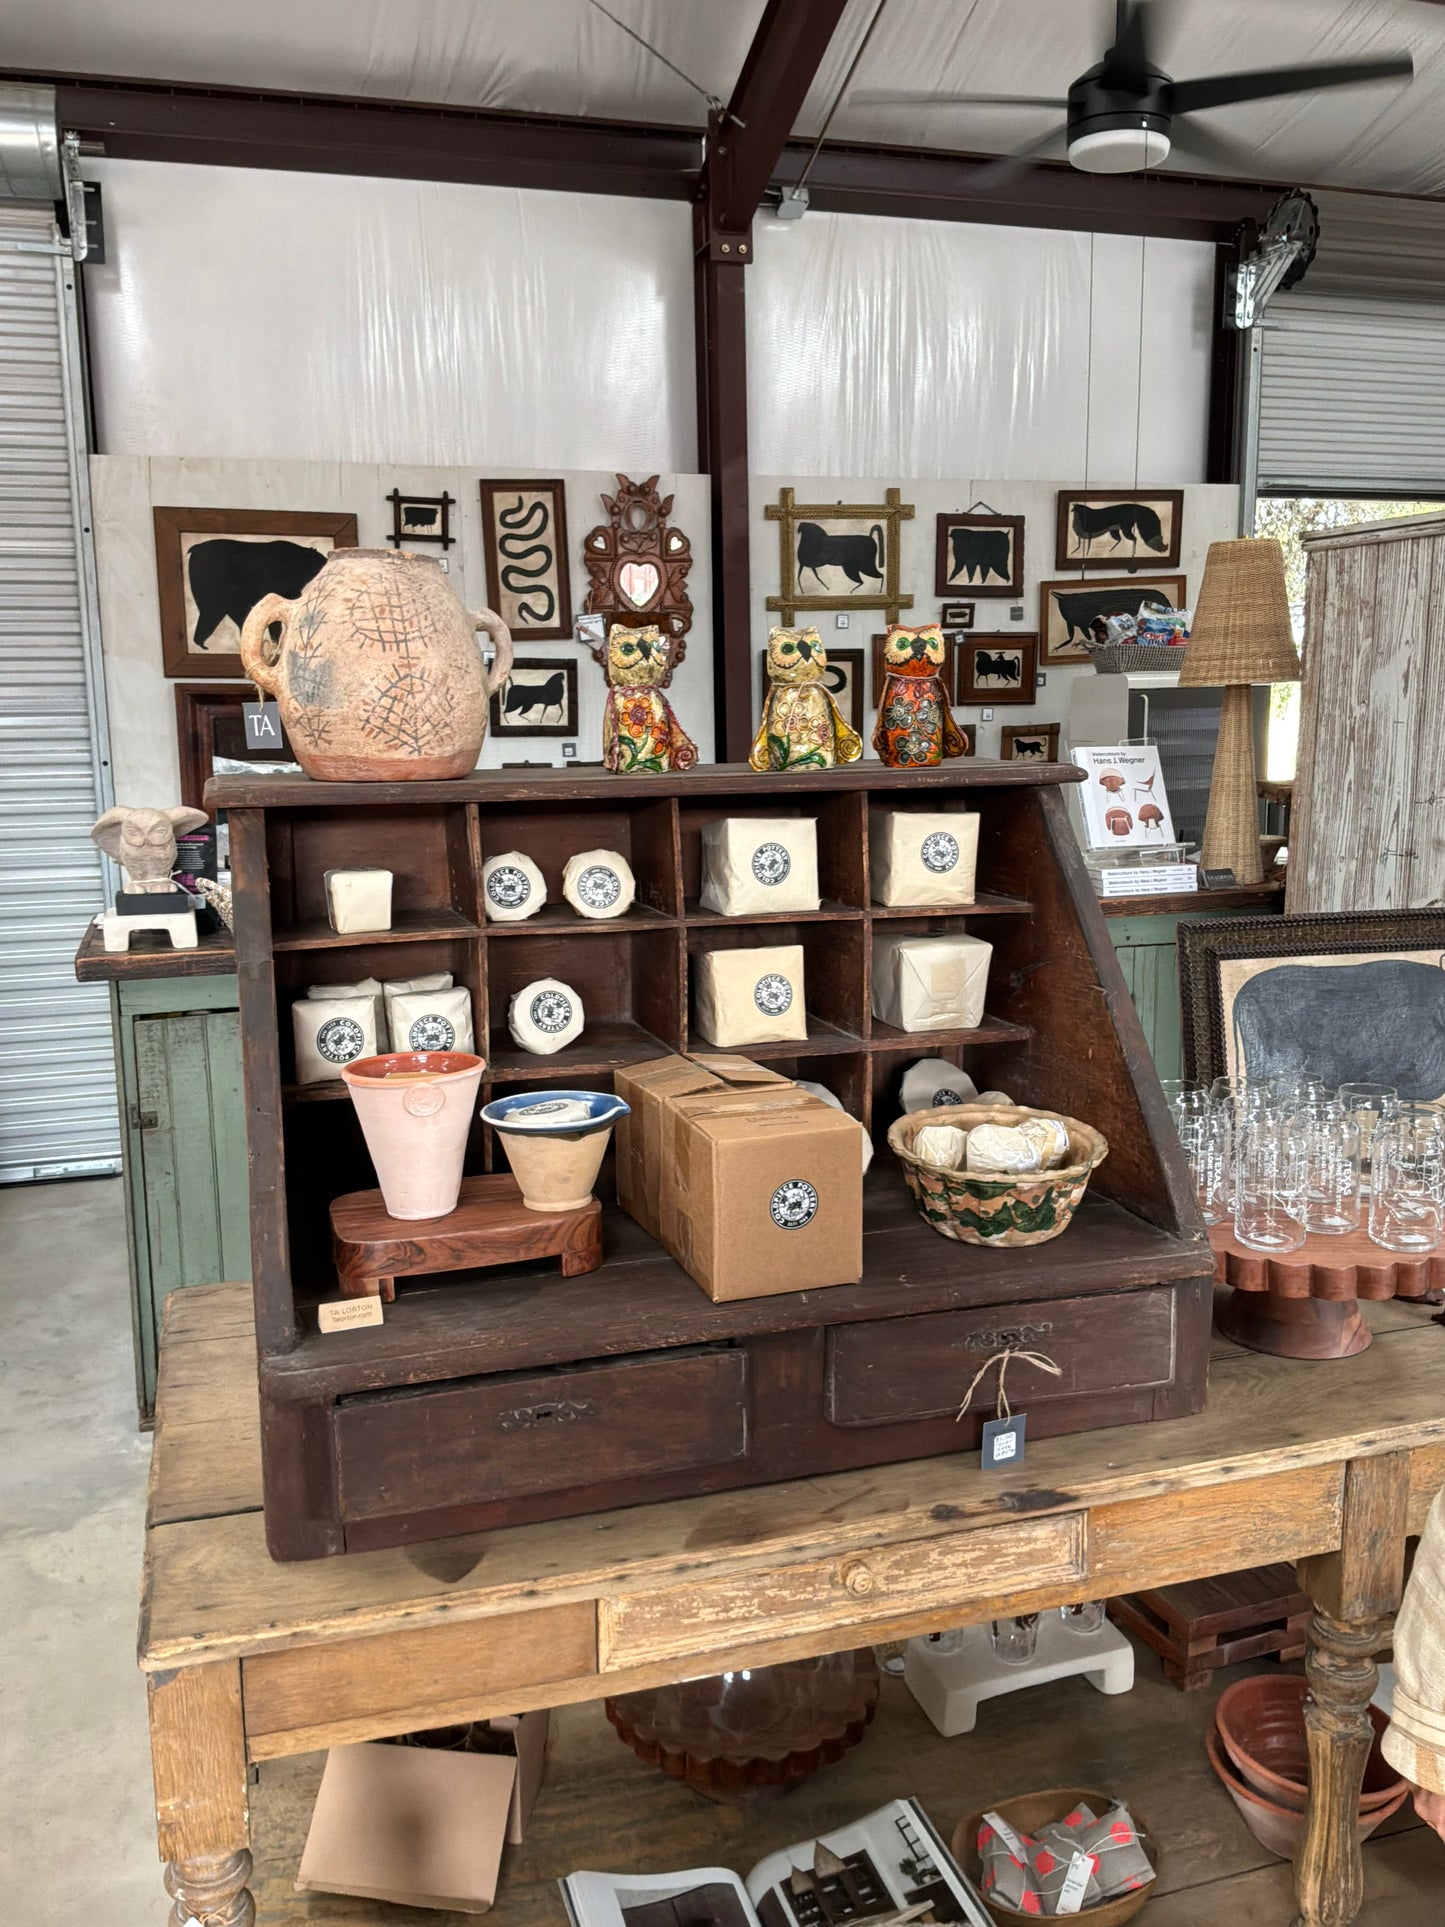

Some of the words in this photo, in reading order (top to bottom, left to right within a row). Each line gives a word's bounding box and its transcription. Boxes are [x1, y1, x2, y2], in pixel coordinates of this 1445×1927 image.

[1143, 631, 1167, 640] Chex
[248, 714, 276, 737] TA
[1093, 757, 1112, 765] Hans
[1119, 757, 1145, 766] Wegner
[512, 869, 529, 898] POTTERY
[579, 873, 593, 903] POTTERY
[540, 993, 570, 1017] COLDPIECE
[339, 1019, 362, 1055] COLDPIECE
[320, 1042, 350, 1061] POTTERY
[1213, 1155, 1222, 1190] TEXAS
[1343, 1163, 1352, 1195] TEXAS
[772, 1182, 794, 1224] COLDPIECE
[797, 1182, 815, 1213] POTTERY
[341, 1304, 373, 1314] LORTON
